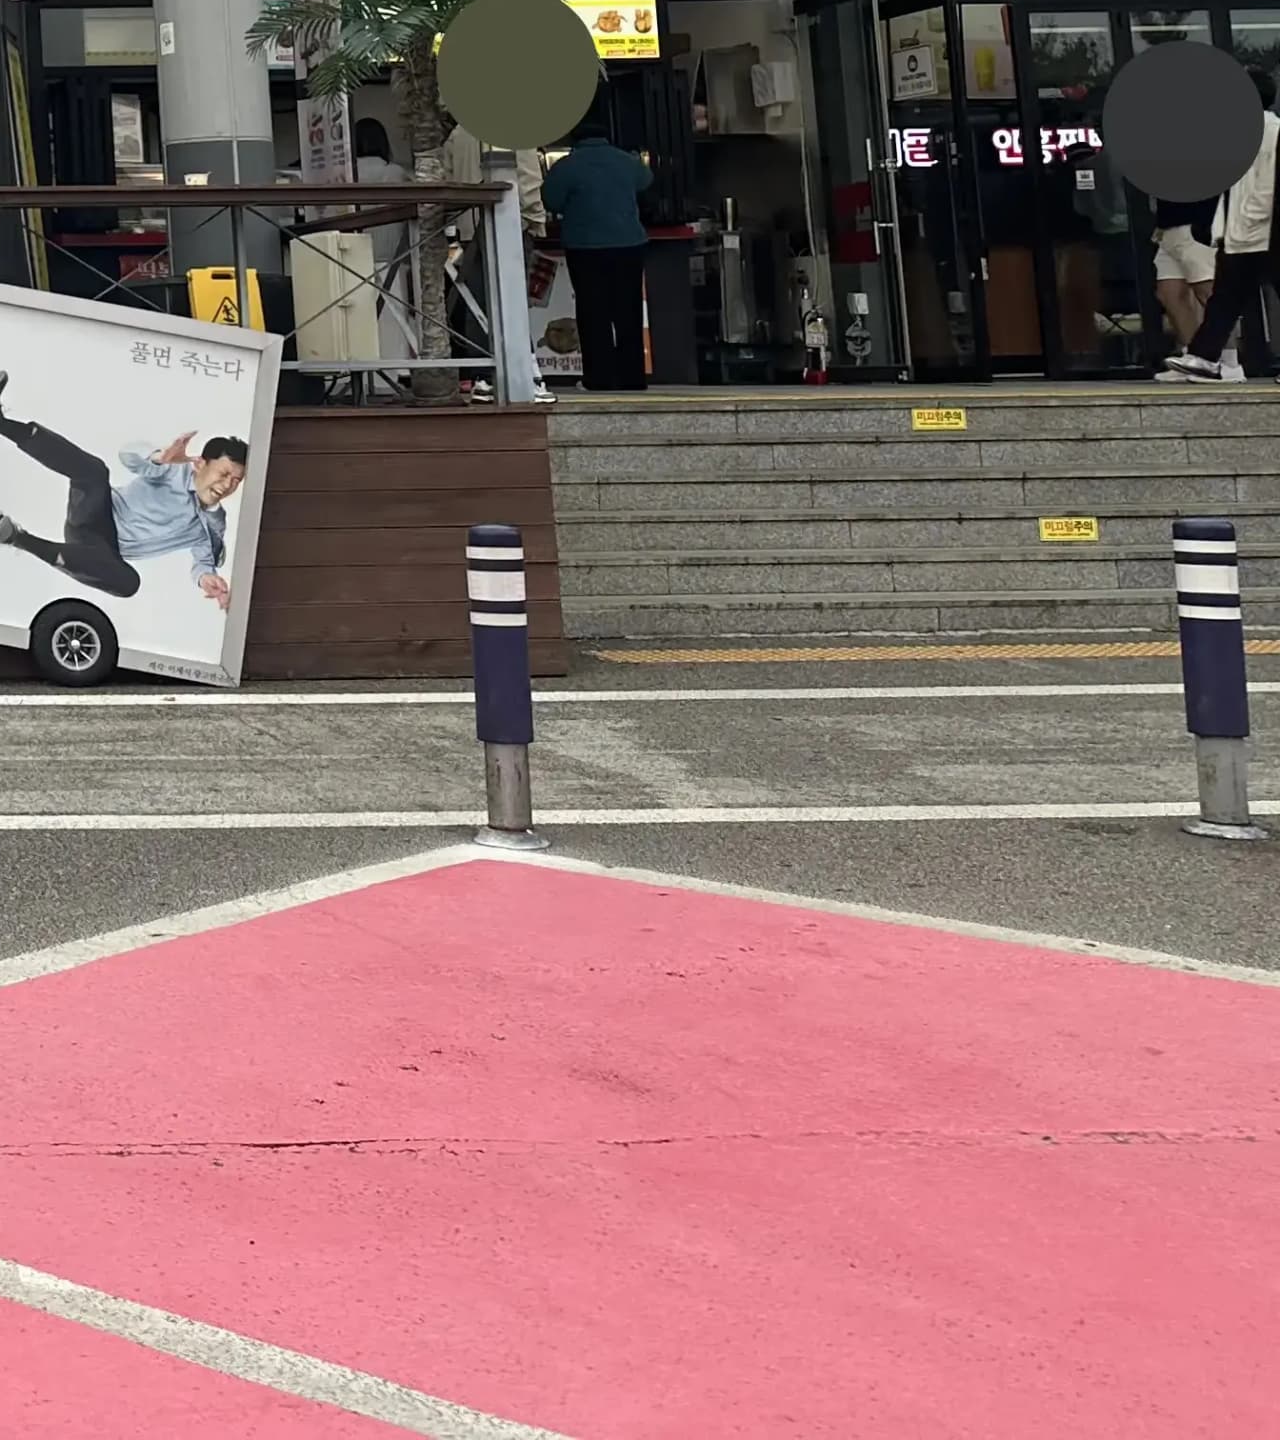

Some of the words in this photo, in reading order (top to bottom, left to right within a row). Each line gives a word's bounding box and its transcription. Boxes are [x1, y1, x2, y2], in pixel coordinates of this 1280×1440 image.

[130, 341, 171, 369] 풀면
[179, 350, 245, 382] 죽는다
[916, 410, 962, 422] 미끄럼주의
[1043, 519, 1093, 532] 미끄럼주의
